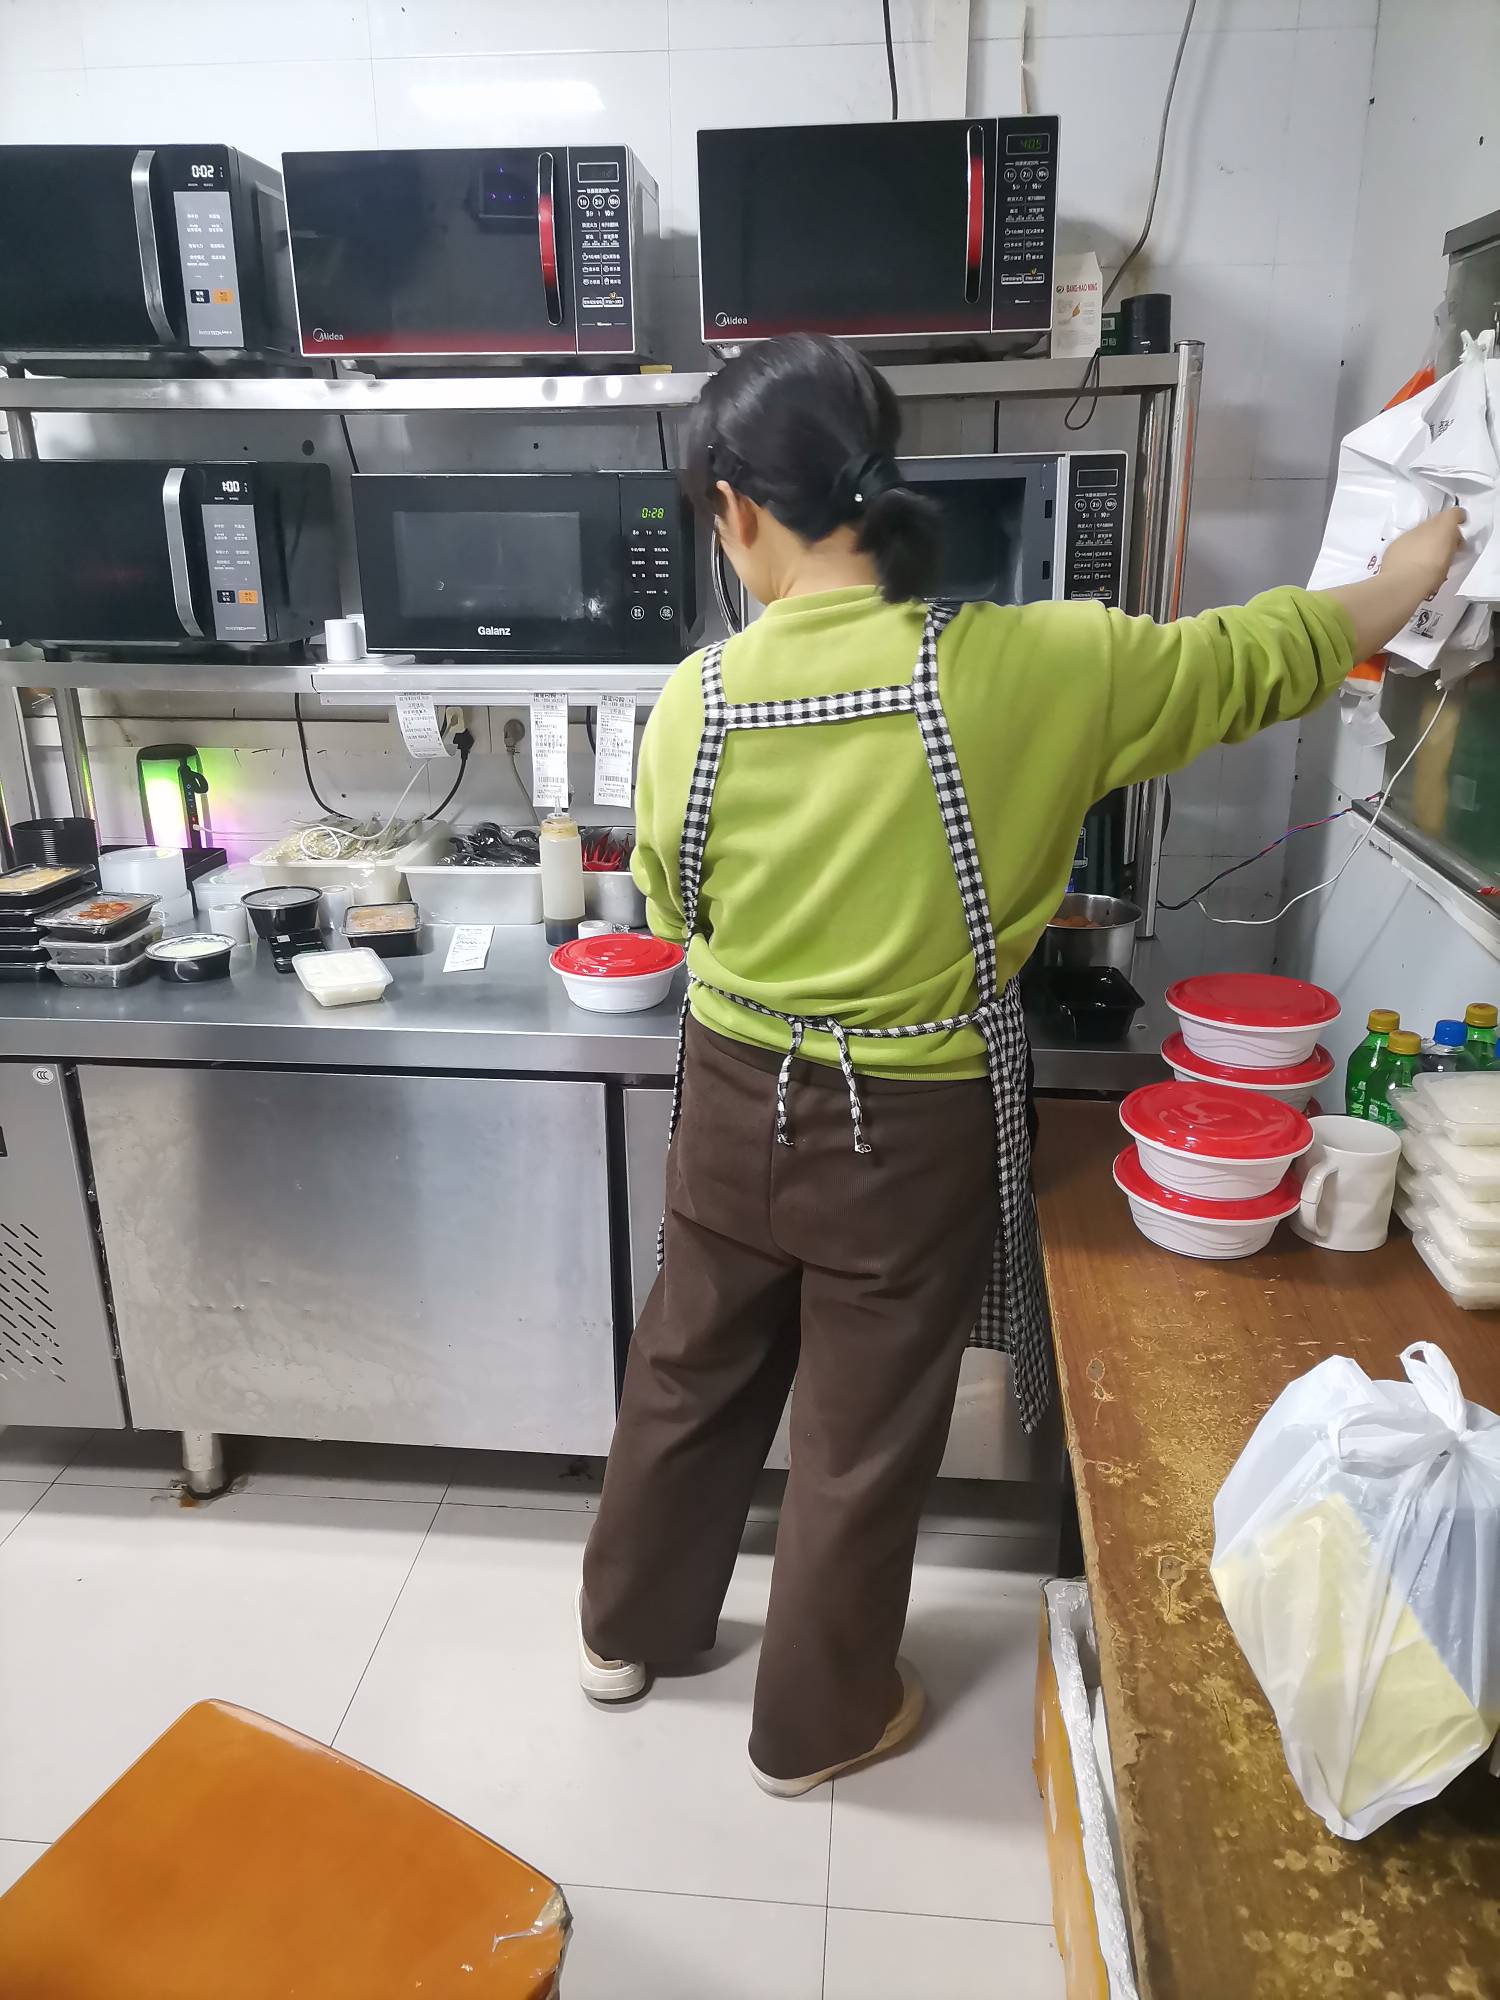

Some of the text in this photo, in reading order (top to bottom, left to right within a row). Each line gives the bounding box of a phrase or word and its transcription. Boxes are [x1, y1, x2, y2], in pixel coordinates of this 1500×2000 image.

[191, 165, 214, 178] 0:02
[715, 312, 748, 327] Midea
[313, 328, 344, 342] Midea
[222, 481, 240, 492] 1:00
[641, 507, 665, 519] 0:28
[477, 626, 511, 636] Galanz
